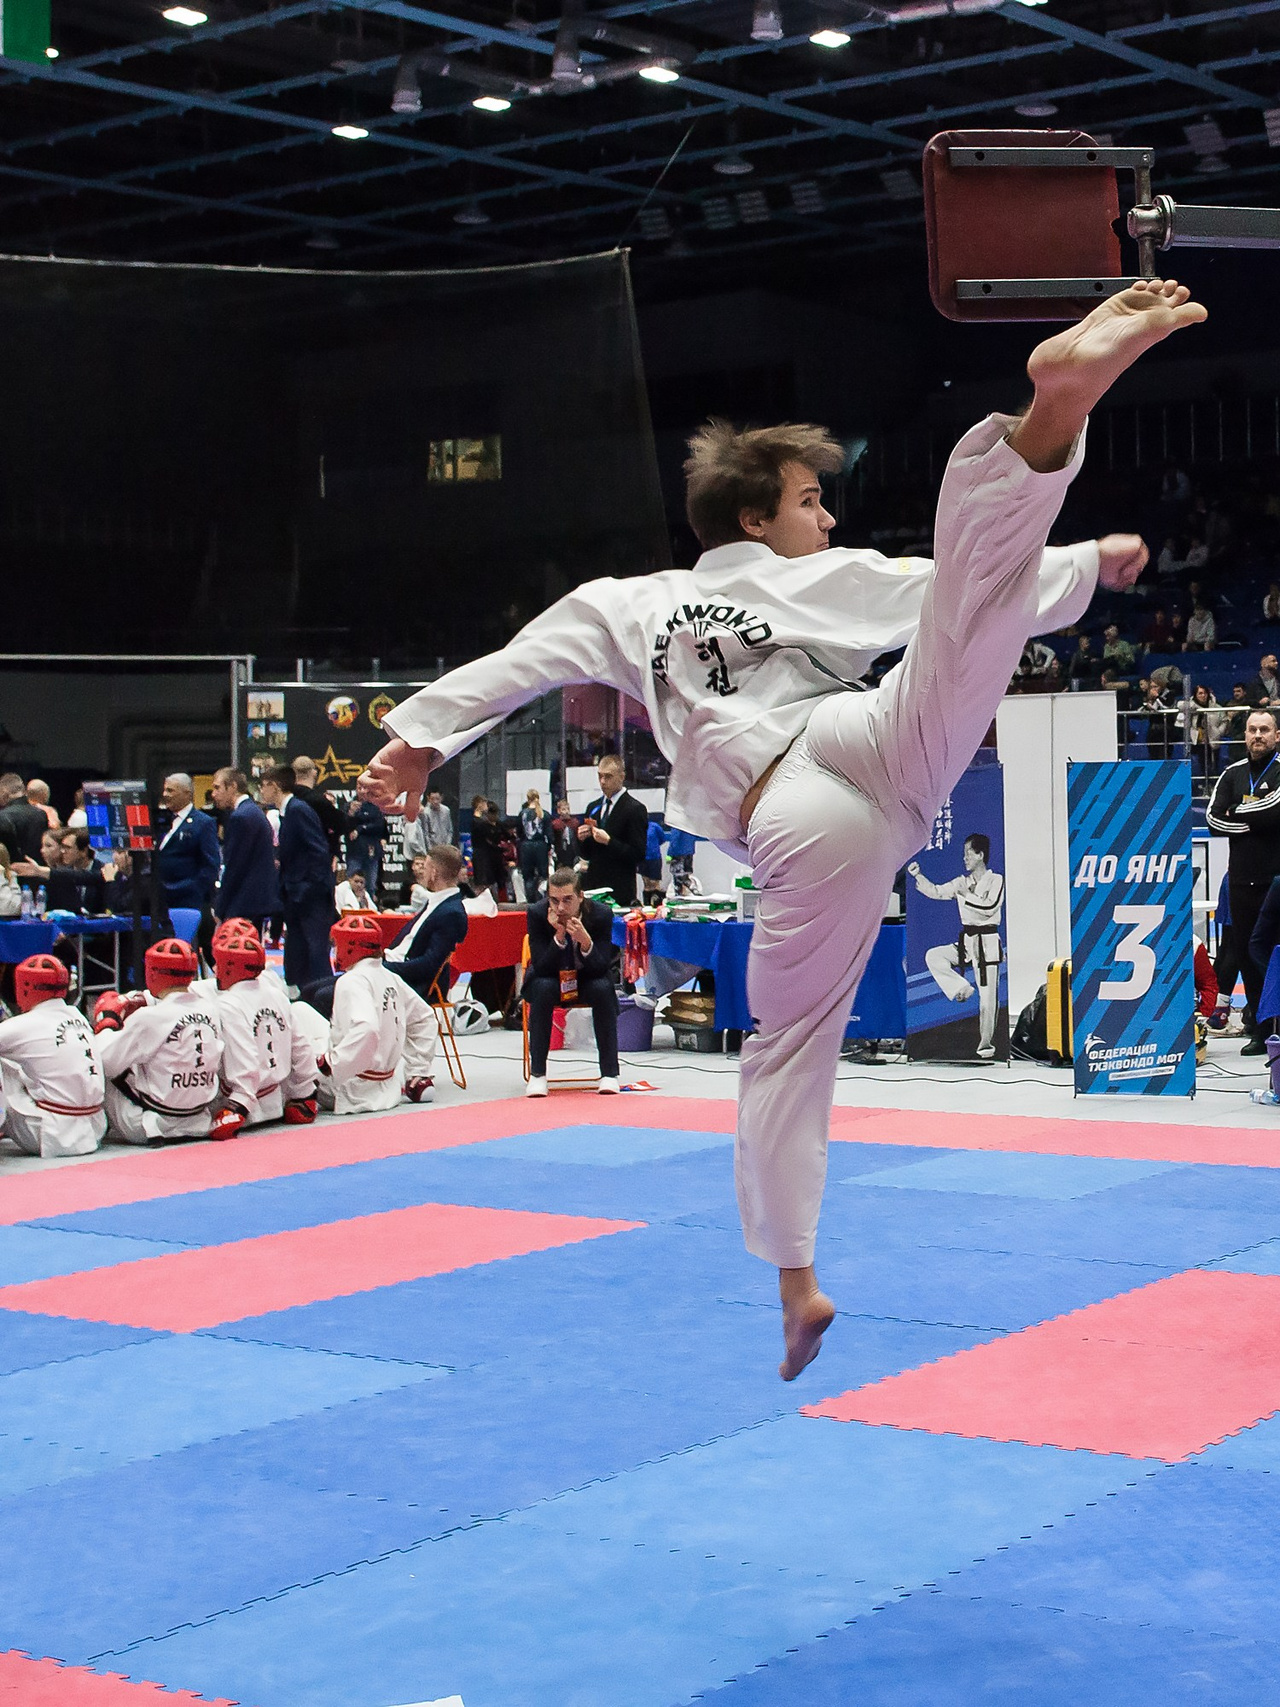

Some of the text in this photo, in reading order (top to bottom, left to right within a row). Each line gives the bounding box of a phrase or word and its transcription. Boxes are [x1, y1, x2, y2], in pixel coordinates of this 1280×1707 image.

[652, 604, 773, 687] TAEKWON-D
[1073, 854, 1187, 888] ДО ЯНГ
[1097, 904, 1166, 1001] 3
[1088, 1043, 1158, 1060] ФЕДЕРАЦИЯ
[1088, 1056, 1154, 1073] ТХЭКВОНДО
[1156, 1052, 1185, 1065] МФТ
